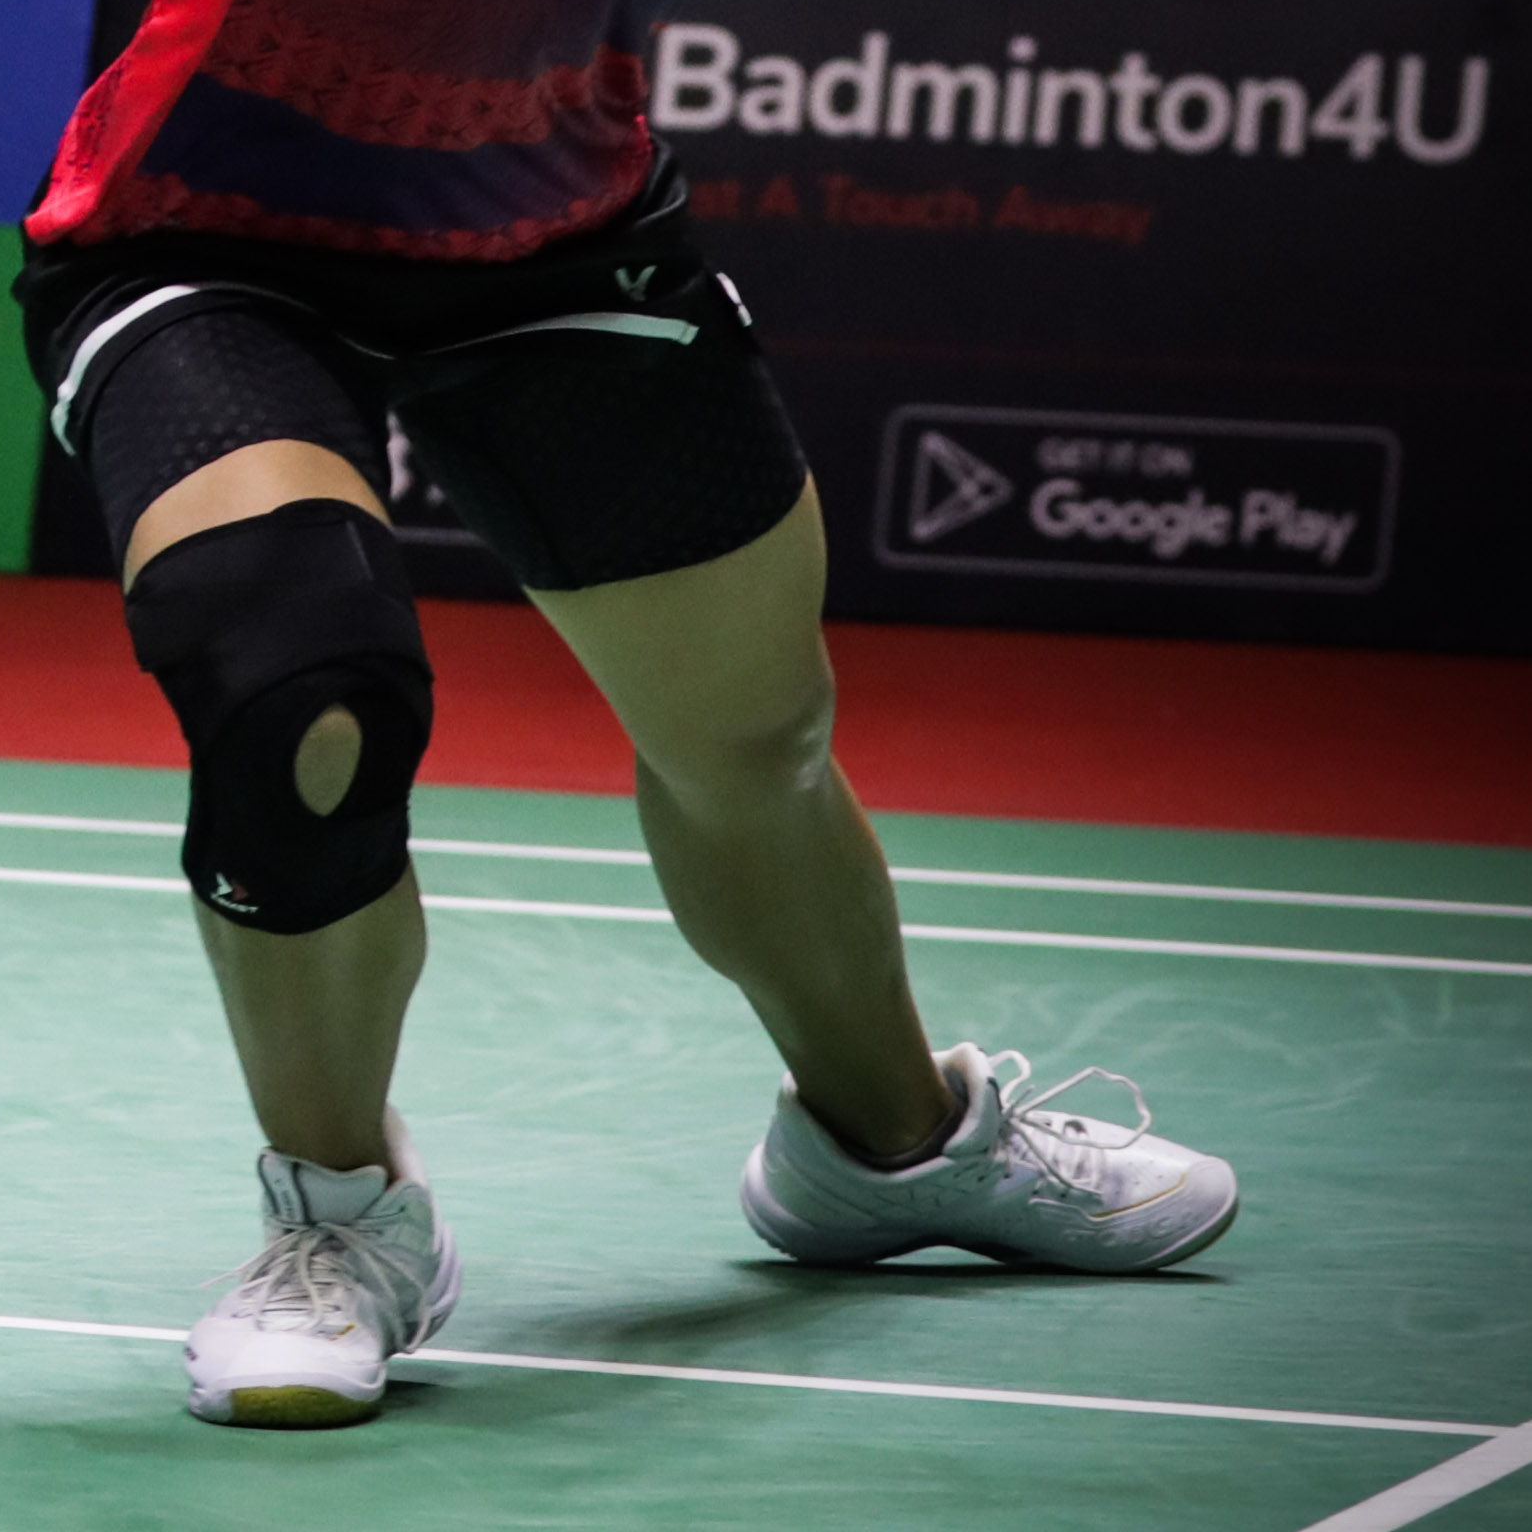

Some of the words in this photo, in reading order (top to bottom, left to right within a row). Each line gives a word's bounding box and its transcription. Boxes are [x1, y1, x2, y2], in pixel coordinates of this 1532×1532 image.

[649, 21, 1492, 167] Badminton4U
[757, 174, 801, 217] A
[822, 171, 981, 228] Touch
[993, 184, 1152, 247] Away
[1029, 476, 1235, 561] Google
[1238, 487, 1359, 567] Play
